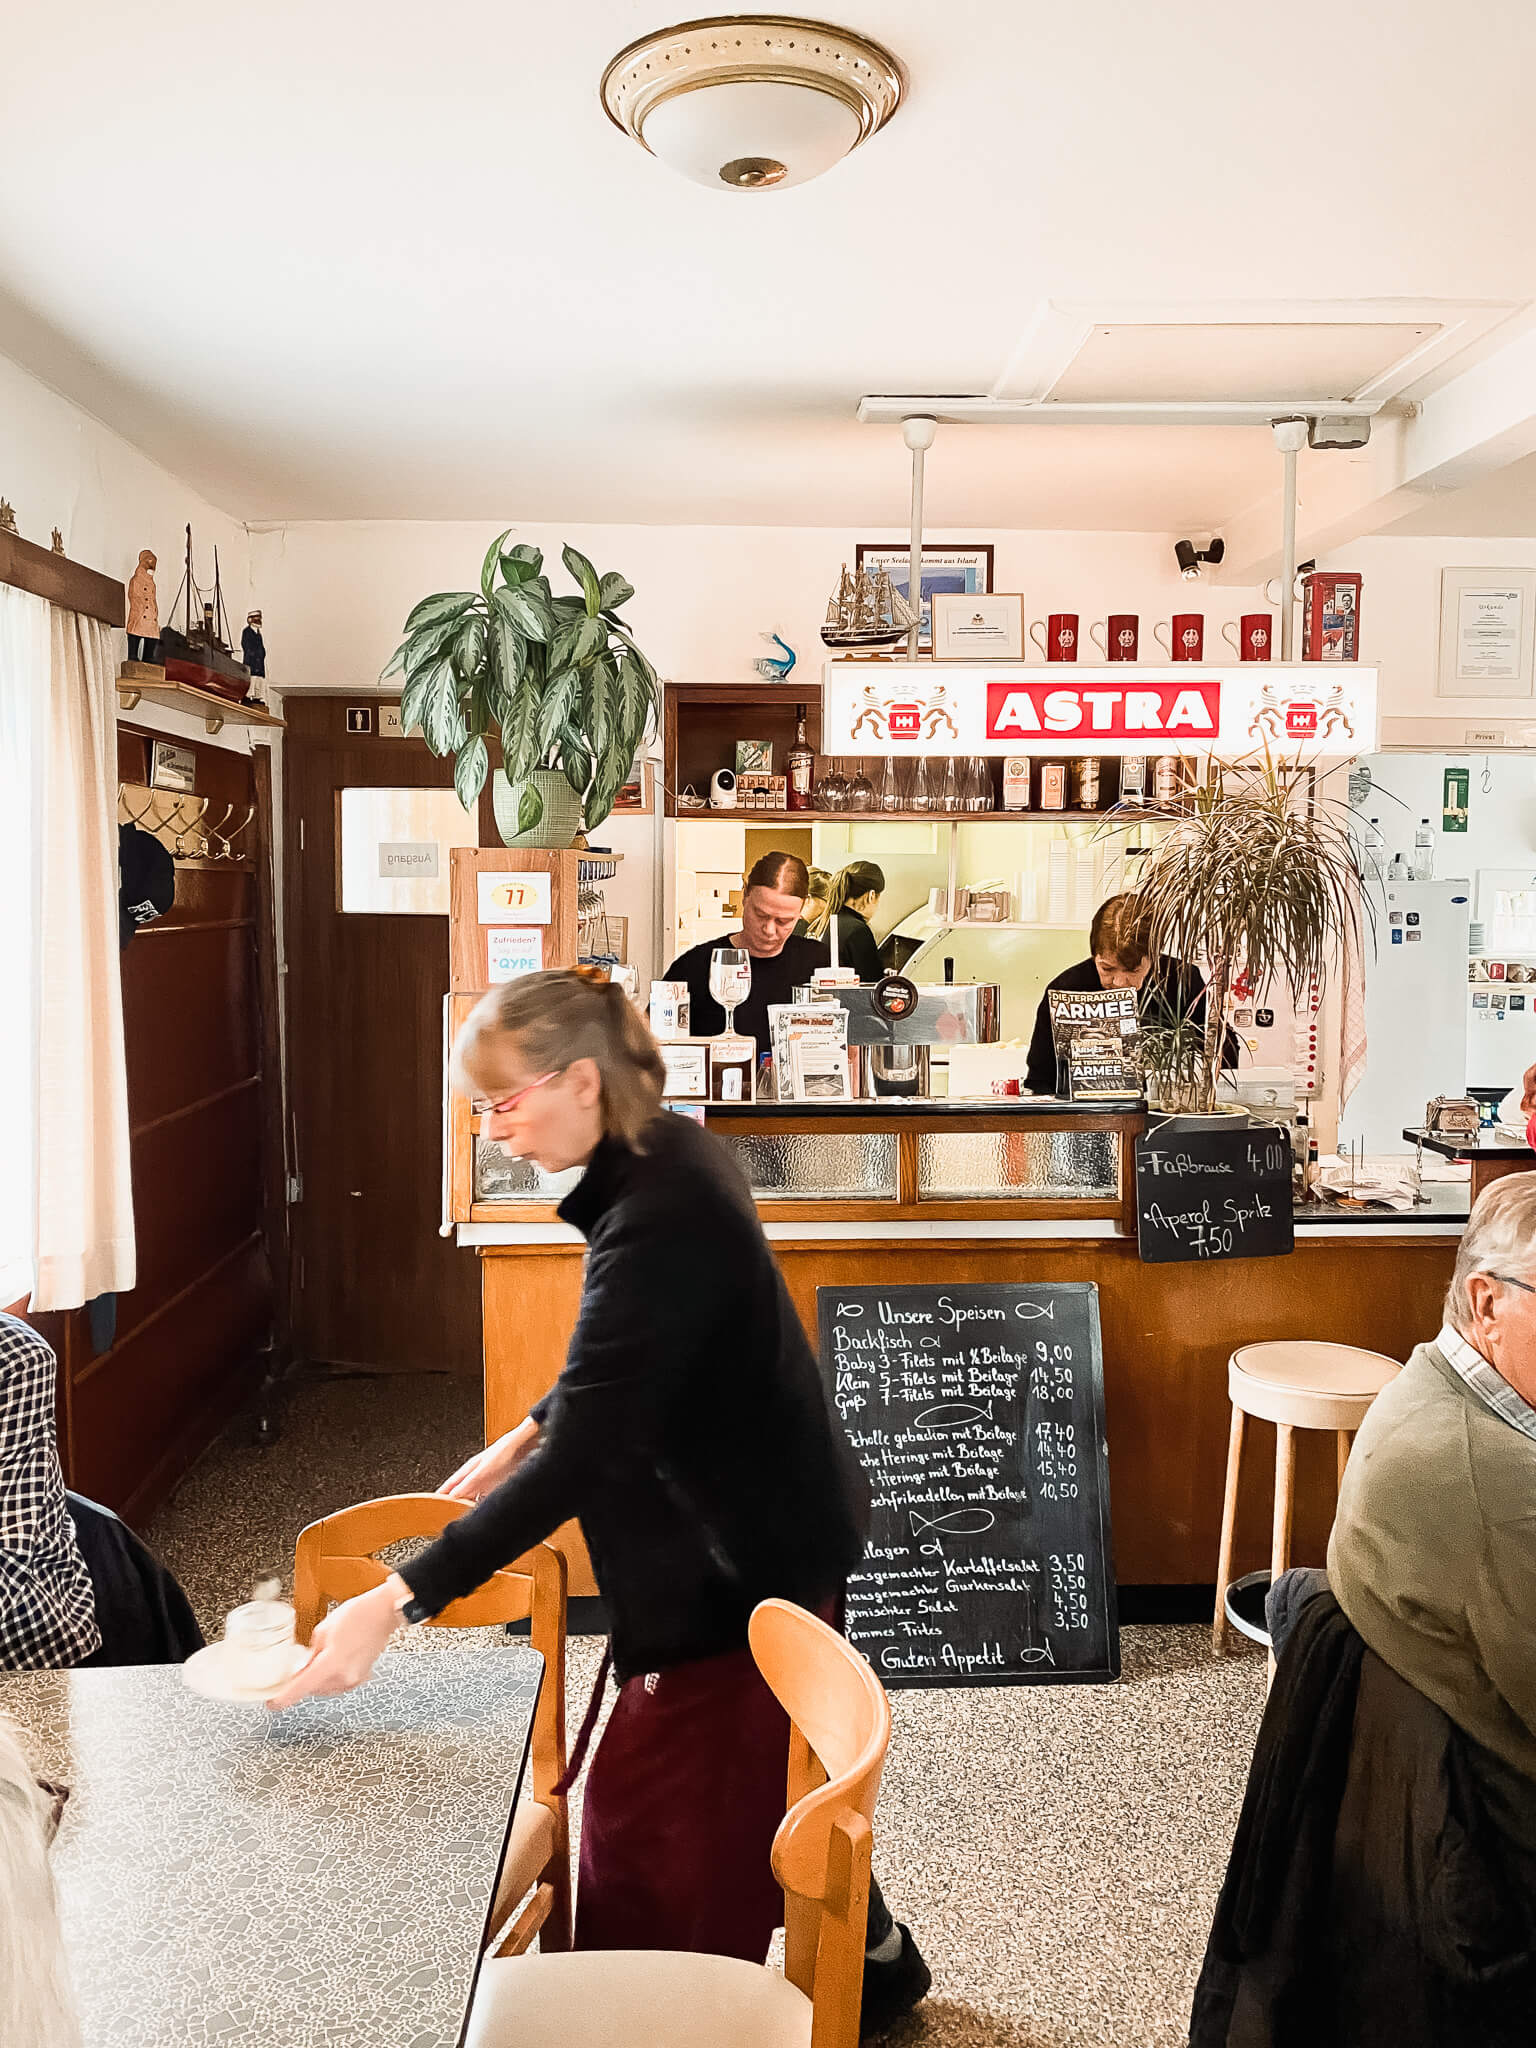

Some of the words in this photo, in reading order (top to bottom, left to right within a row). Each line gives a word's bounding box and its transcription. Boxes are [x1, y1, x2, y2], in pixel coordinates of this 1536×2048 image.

[993, 690, 1214, 731] ASTRA
[506, 889, 525, 905] 77
[493, 936, 537, 944] Zufrieden?
[499, 958, 537, 969] QYPE
[1052, 992, 1068, 1001] DIE
[1069, 991, 1133, 1002] TERRAKOTTA
[1055, 1000, 1134, 1019] ARMEE
[1073, 1065, 1122, 1077] ARMEE
[1138, 1151, 1235, 1177] Faßbrause
[1247, 1144, 1283, 1176] 4,00
[1148, 1200, 1213, 1238] Aperol
[1187, 1225, 1233, 1257] 7,50
[878, 1301, 934, 1325] Unsere
[938, 1296, 1006, 1332] Speisen
[833, 1326, 912, 1353] Backfisch
[834, 1353, 875, 1374] Baby
[942, 1351, 965, 1366] mit
[981, 1347, 1028, 1372] Beilage
[1035, 1341, 1073, 1366] 9,00
[835, 1374, 870, 1392] Klein
[942, 1369, 965, 1384] mit
[968, 1368, 1019, 1389] Beilage
[1030, 1367, 1073, 1387] 14,50
[834, 1393, 867, 1420] Groß
[941, 1384, 964, 1397] mit
[968, 1382, 1017, 1402] Beilage
[1031, 1385, 1074, 1403] 18,00
[893, 1425, 949, 1451] gebacken
[951, 1427, 972, 1442] mit
[971, 1424, 1017, 1445] Beilage
[1035, 1422, 1074, 1442] 17,40
[881, 1446, 930, 1471] Heringe
[932, 1445, 953, 1460] mit
[957, 1442, 1005, 1467] Beilage
[1036, 1442, 1076, 1462] 14,40
[876, 1467, 927, 1491] Heringe
[928, 1464, 950, 1479] mit
[952, 1462, 1000, 1483] Beilage
[1036, 1460, 1077, 1480] 15,40
[967, 1484, 986, 1500] mit
[986, 1484, 1028, 1503] Beilage
[1039, 1482, 1078, 1501] 10,50
[942, 1556, 1040, 1579] Kartoffelsalat
[1049, 1553, 1085, 1574] 3,50
[945, 1579, 1031, 1595] Gurkensalat
[1051, 1574, 1086, 1592] 3,50
[917, 1599, 959, 1615] Salat
[1054, 1591, 1087, 1613] 4,50
[844, 1626, 895, 1642] Pommes
[898, 1621, 943, 1637] Frites
[1054, 1612, 1088, 1631] 3,50
[881, 1645, 936, 1669] Guten
[940, 1642, 1006, 1673] Appetit
